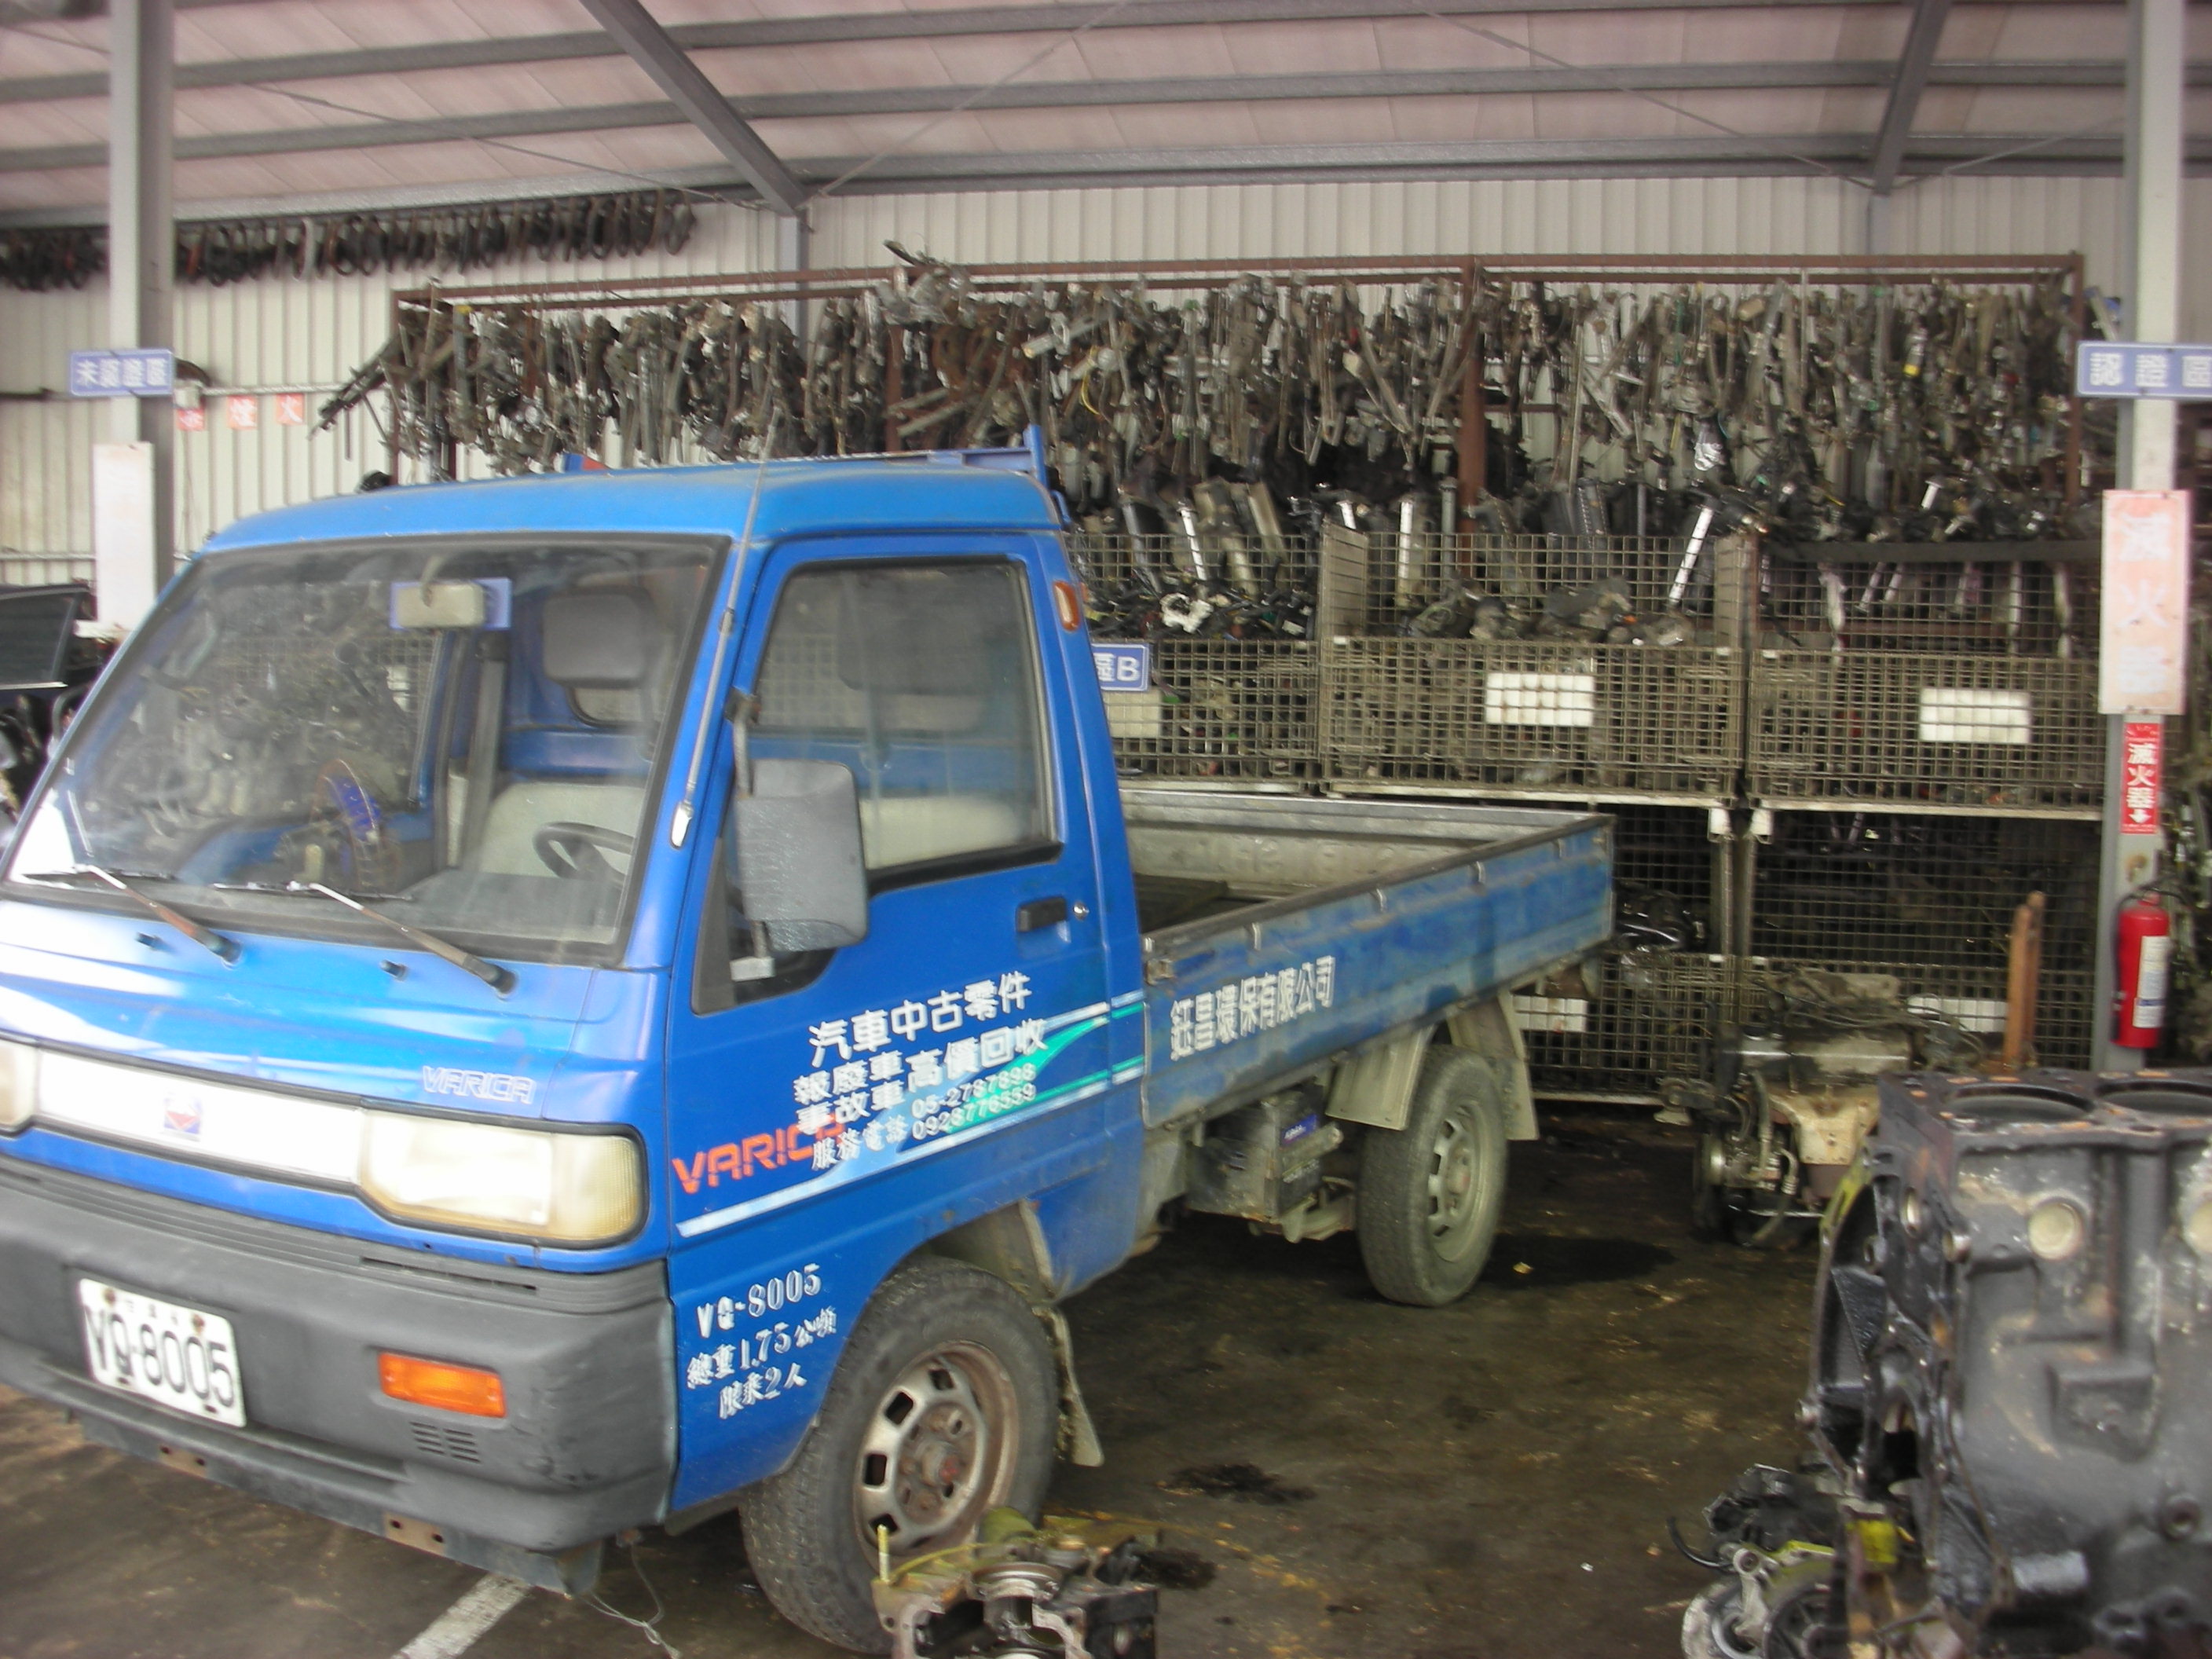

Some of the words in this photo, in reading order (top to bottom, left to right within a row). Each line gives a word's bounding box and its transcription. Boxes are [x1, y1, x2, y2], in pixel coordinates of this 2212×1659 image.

[2119, 512, 2171, 694] 滅火器
[2126, 742, 2157, 809] 滅火器
[808, 971, 1032, 1068] 汽車中古零件
[422, 1065, 537, 1104] VARICA
[793, 1049, 905, 1104] 報廢車
[905, 1018, 1049, 1093] 高價回收
[795, 1079, 906, 1133] 事故車
[811, 1114, 909, 1170] 服務電話
